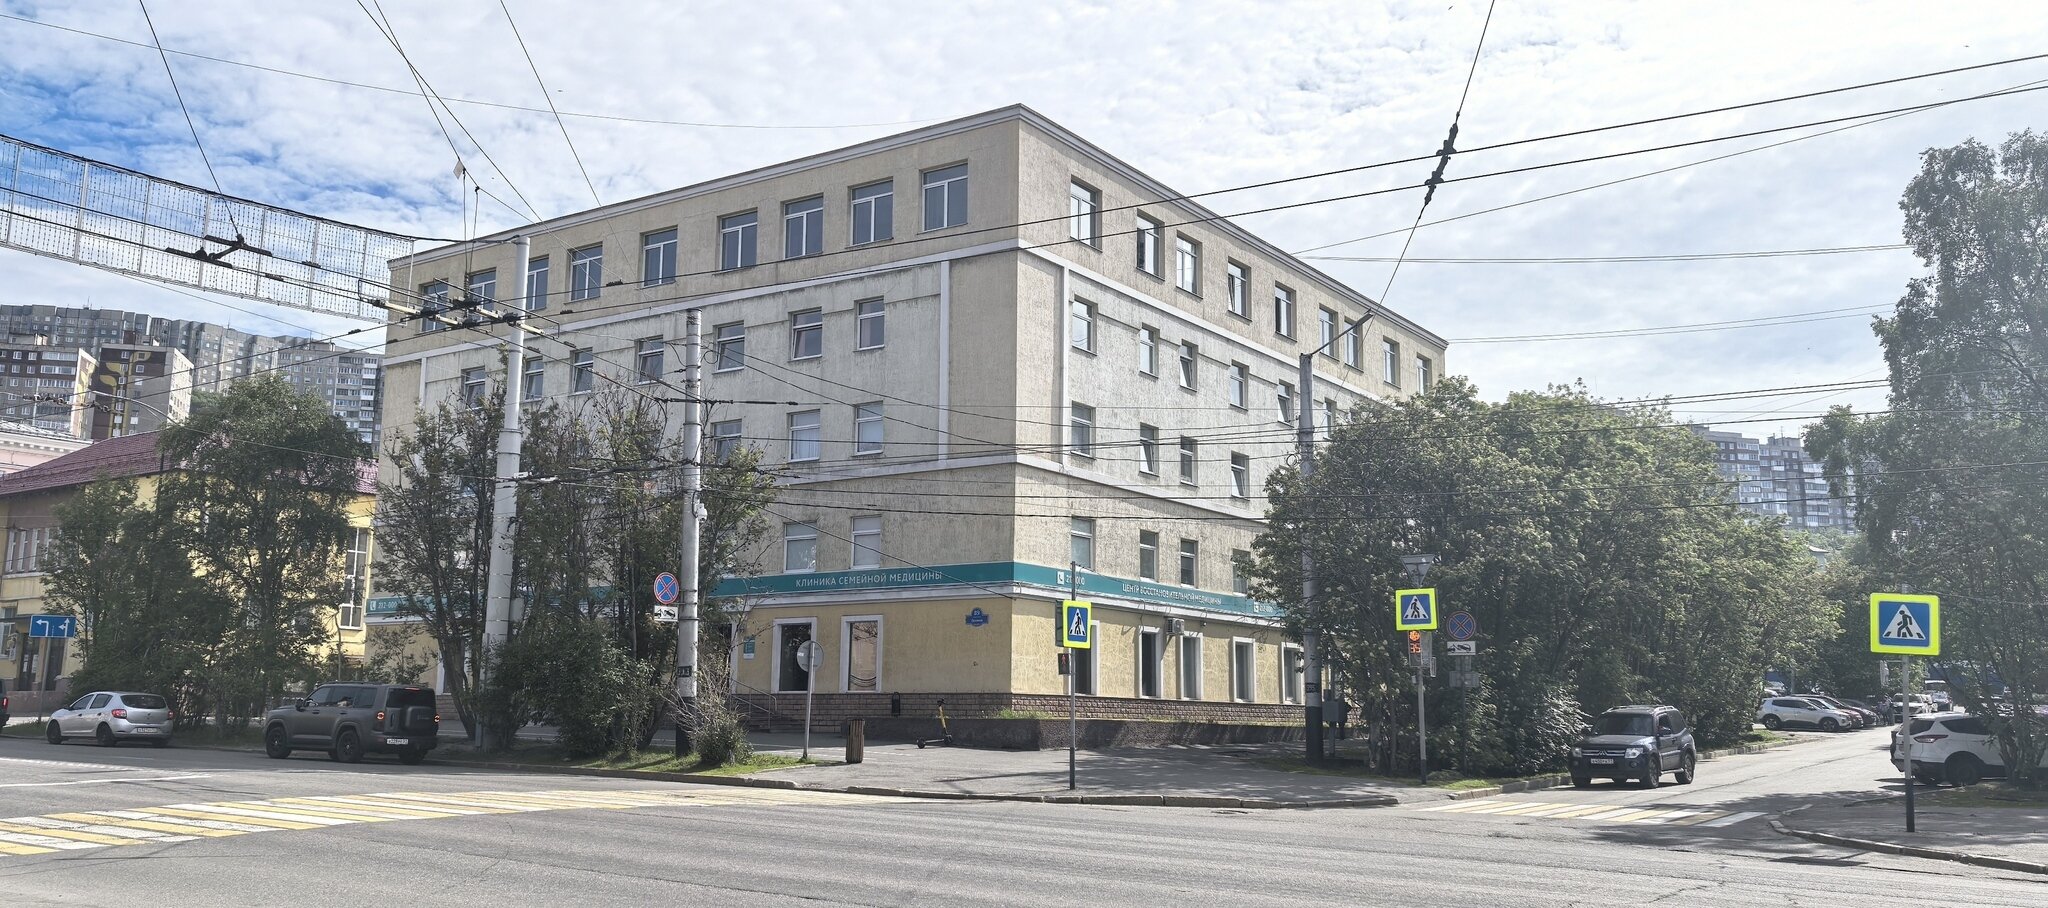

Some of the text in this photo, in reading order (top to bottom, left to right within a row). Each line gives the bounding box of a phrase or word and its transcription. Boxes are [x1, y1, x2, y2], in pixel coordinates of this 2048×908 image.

[795, 571, 943, 588] КЛИНИКА СЕМЕЙНОЙ МЕДИЦИНЫ
[1122, 583, 1140, 593] ЦЕНТР
